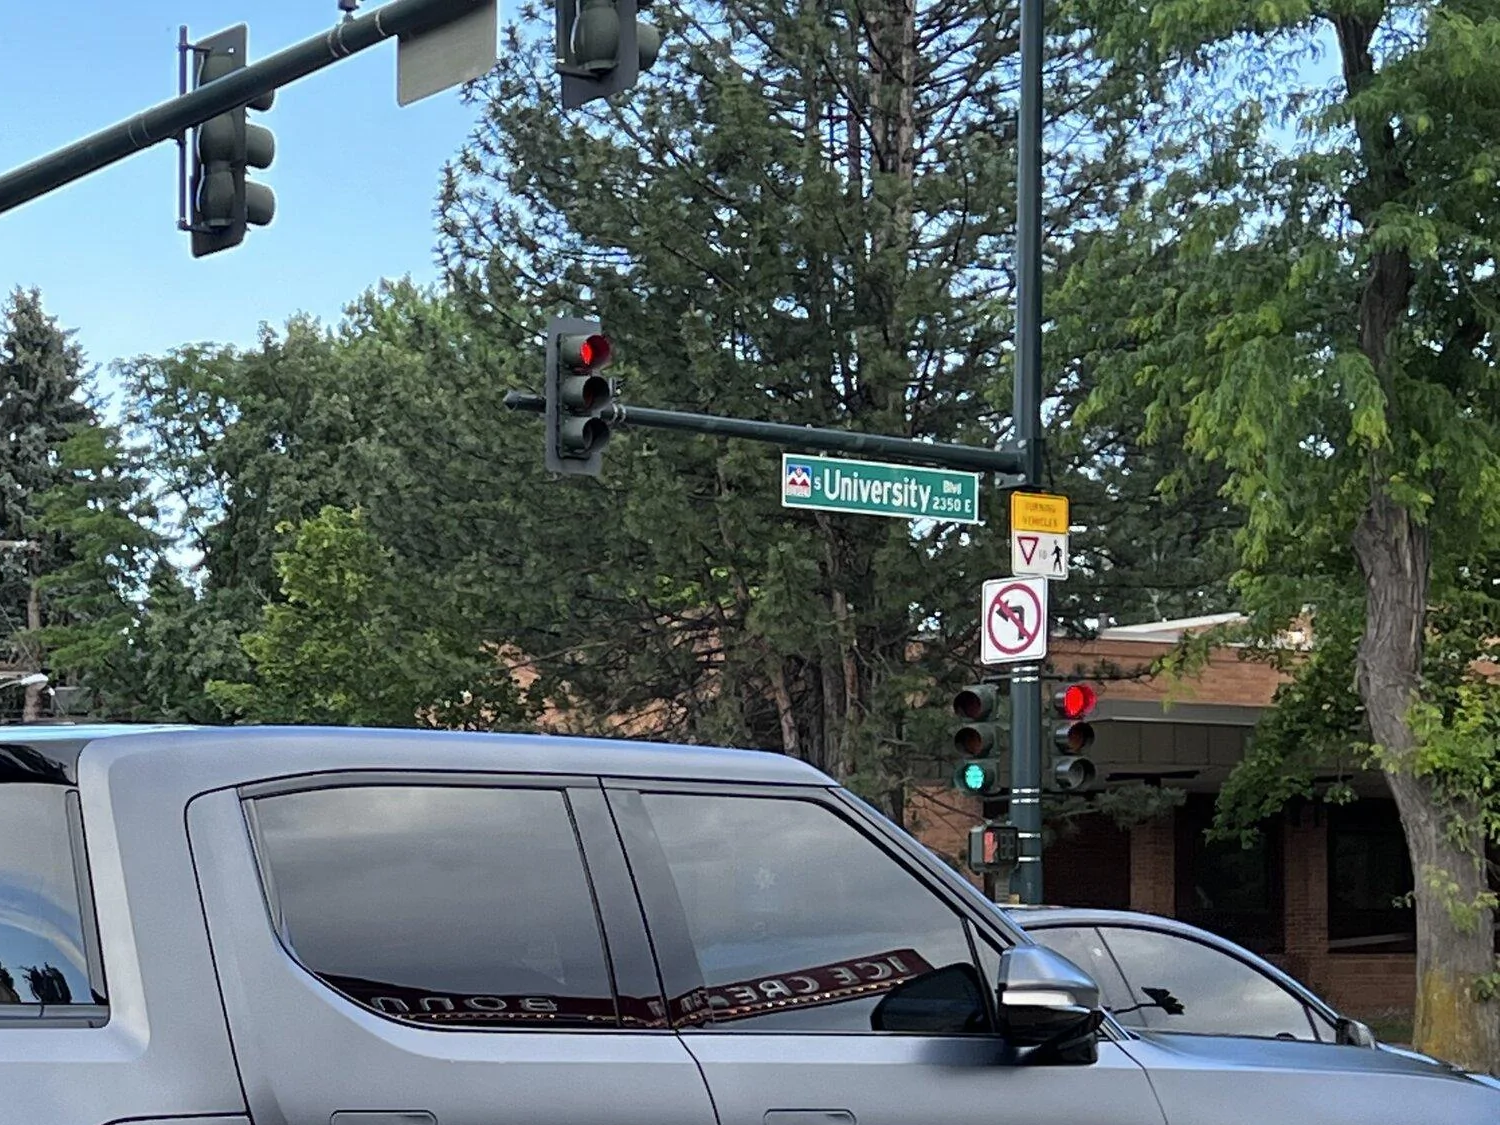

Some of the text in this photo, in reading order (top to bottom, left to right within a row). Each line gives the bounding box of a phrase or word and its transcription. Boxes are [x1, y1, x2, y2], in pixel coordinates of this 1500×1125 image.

[814, 476, 822, 491] S
[824, 468, 931, 512] University
[932, 497, 972, 512] 2350 E
